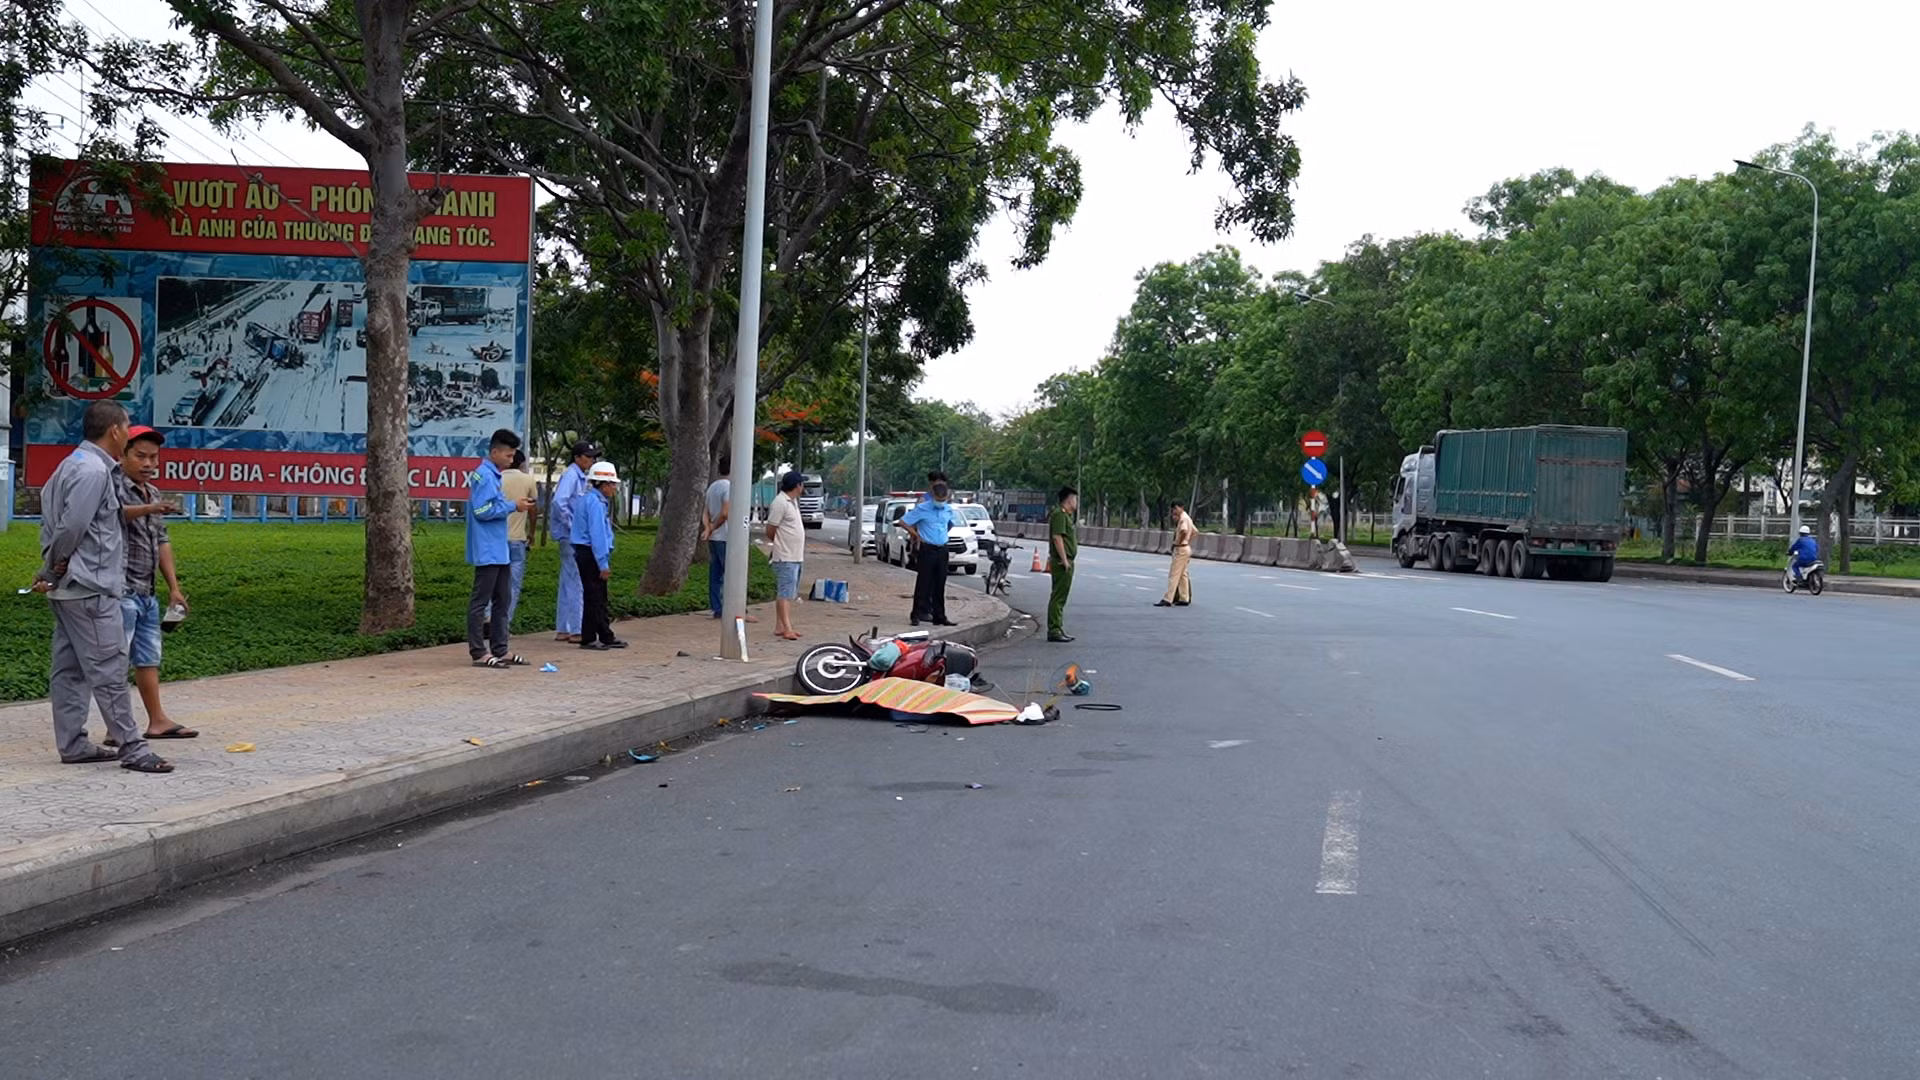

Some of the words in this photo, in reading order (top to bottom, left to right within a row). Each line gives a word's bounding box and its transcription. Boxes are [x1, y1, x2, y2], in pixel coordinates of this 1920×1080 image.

[173, 179, 238, 214] VƯỢT
[311, 182, 374, 213] PHÓN
[198, 219, 236, 238] ANH
[241, 214, 278, 239] CỦA
[283, 220, 354, 243] THƯƠNG
[413, 226, 450, 246] ANG
[165, 460, 225, 485] RƯỢU
[230, 463, 263, 482] BIA
[280, 462, 355, 485] KHÔNG
[425, 466, 456, 488] LÁI
[461, 470, 474, 488] X
